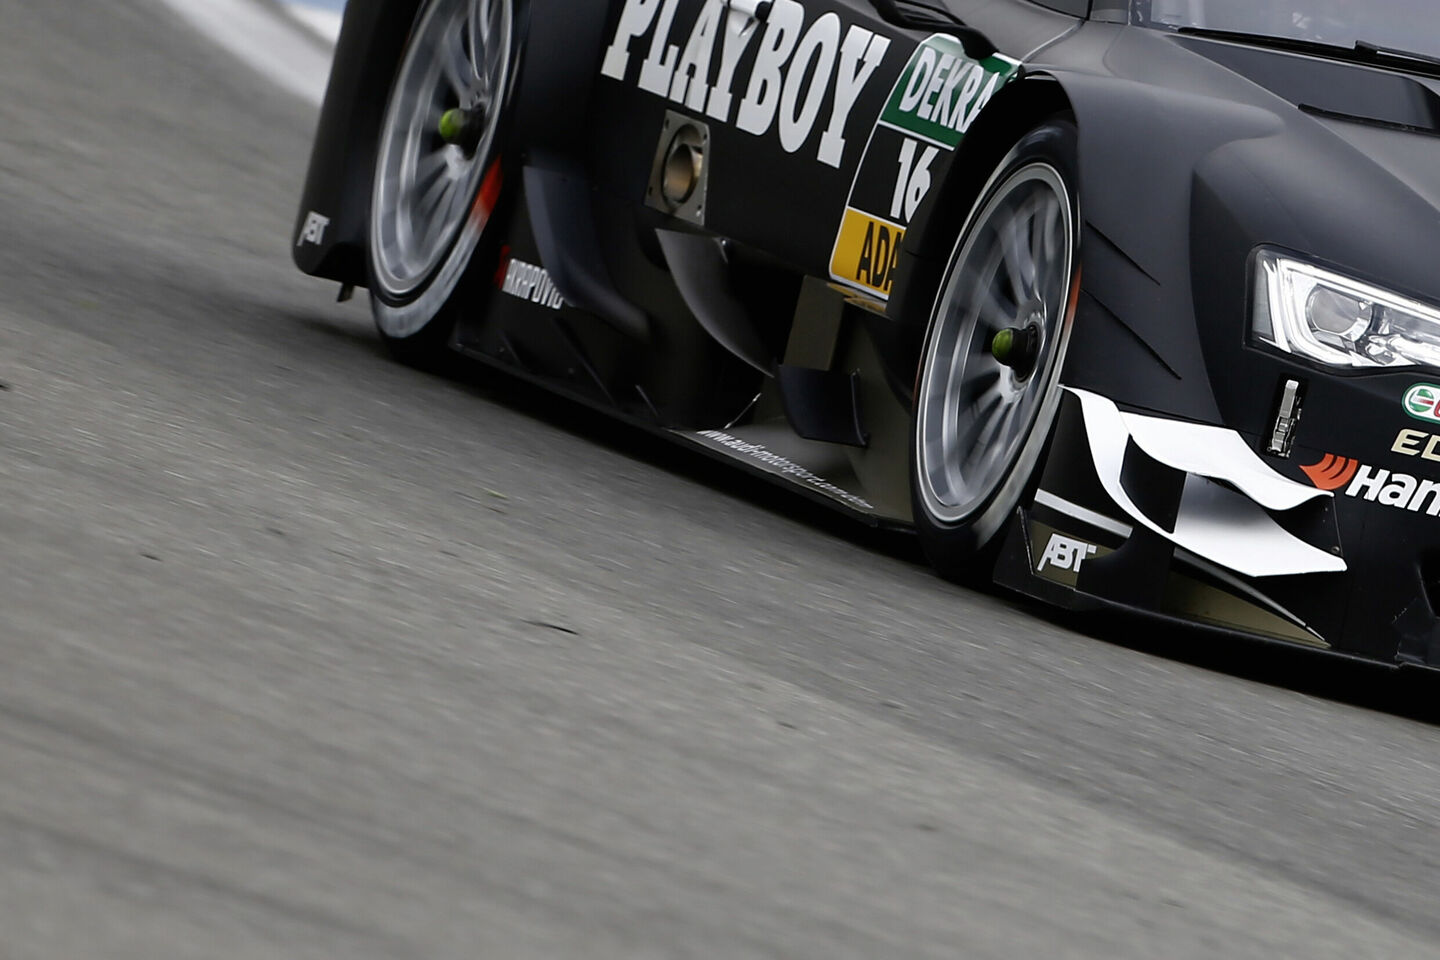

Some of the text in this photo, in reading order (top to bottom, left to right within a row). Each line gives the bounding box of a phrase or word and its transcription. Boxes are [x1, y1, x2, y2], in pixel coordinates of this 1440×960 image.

[898, 46, 1001, 134] DEKRA
[890, 138, 940, 223] 16
[296, 210, 330, 247] ABT
[1037, 533, 1088, 573] ABT
